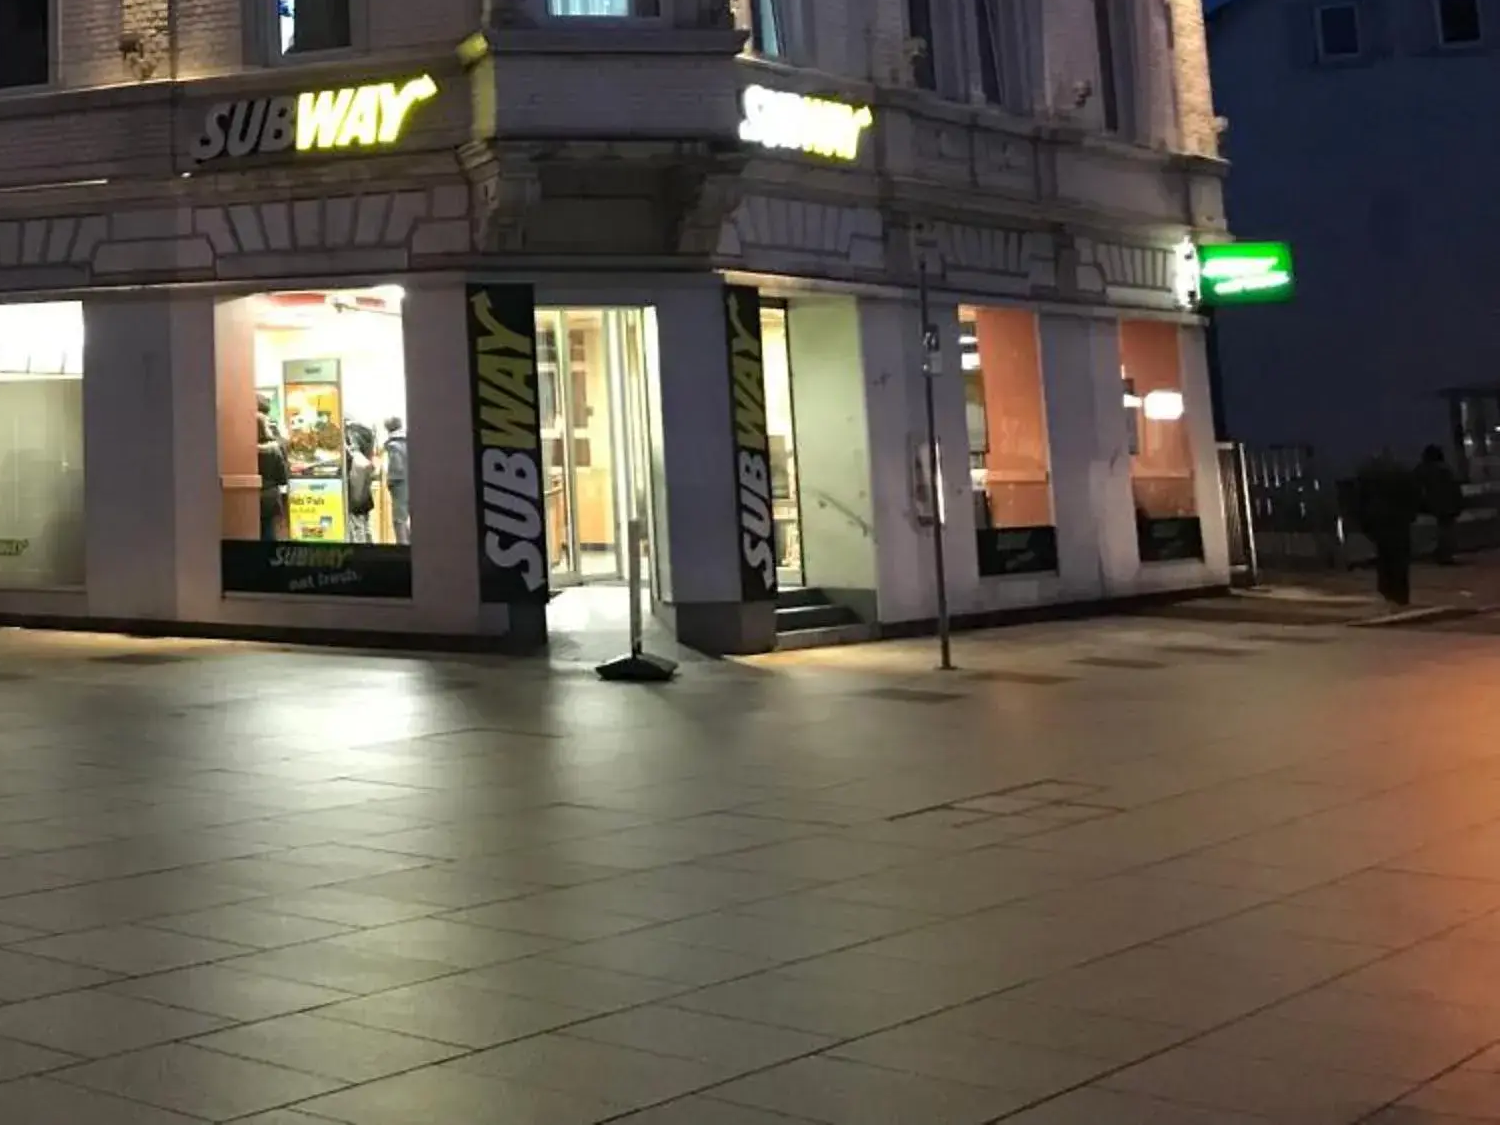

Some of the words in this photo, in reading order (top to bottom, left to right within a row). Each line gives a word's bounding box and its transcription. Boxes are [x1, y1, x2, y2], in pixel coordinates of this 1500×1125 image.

[190, 74, 438, 162] SUBWAY
[470, 290, 547, 592] SUBWAY
[728, 292, 775, 592] SUBWAY
[268, 546, 355, 569] SUBWAY
